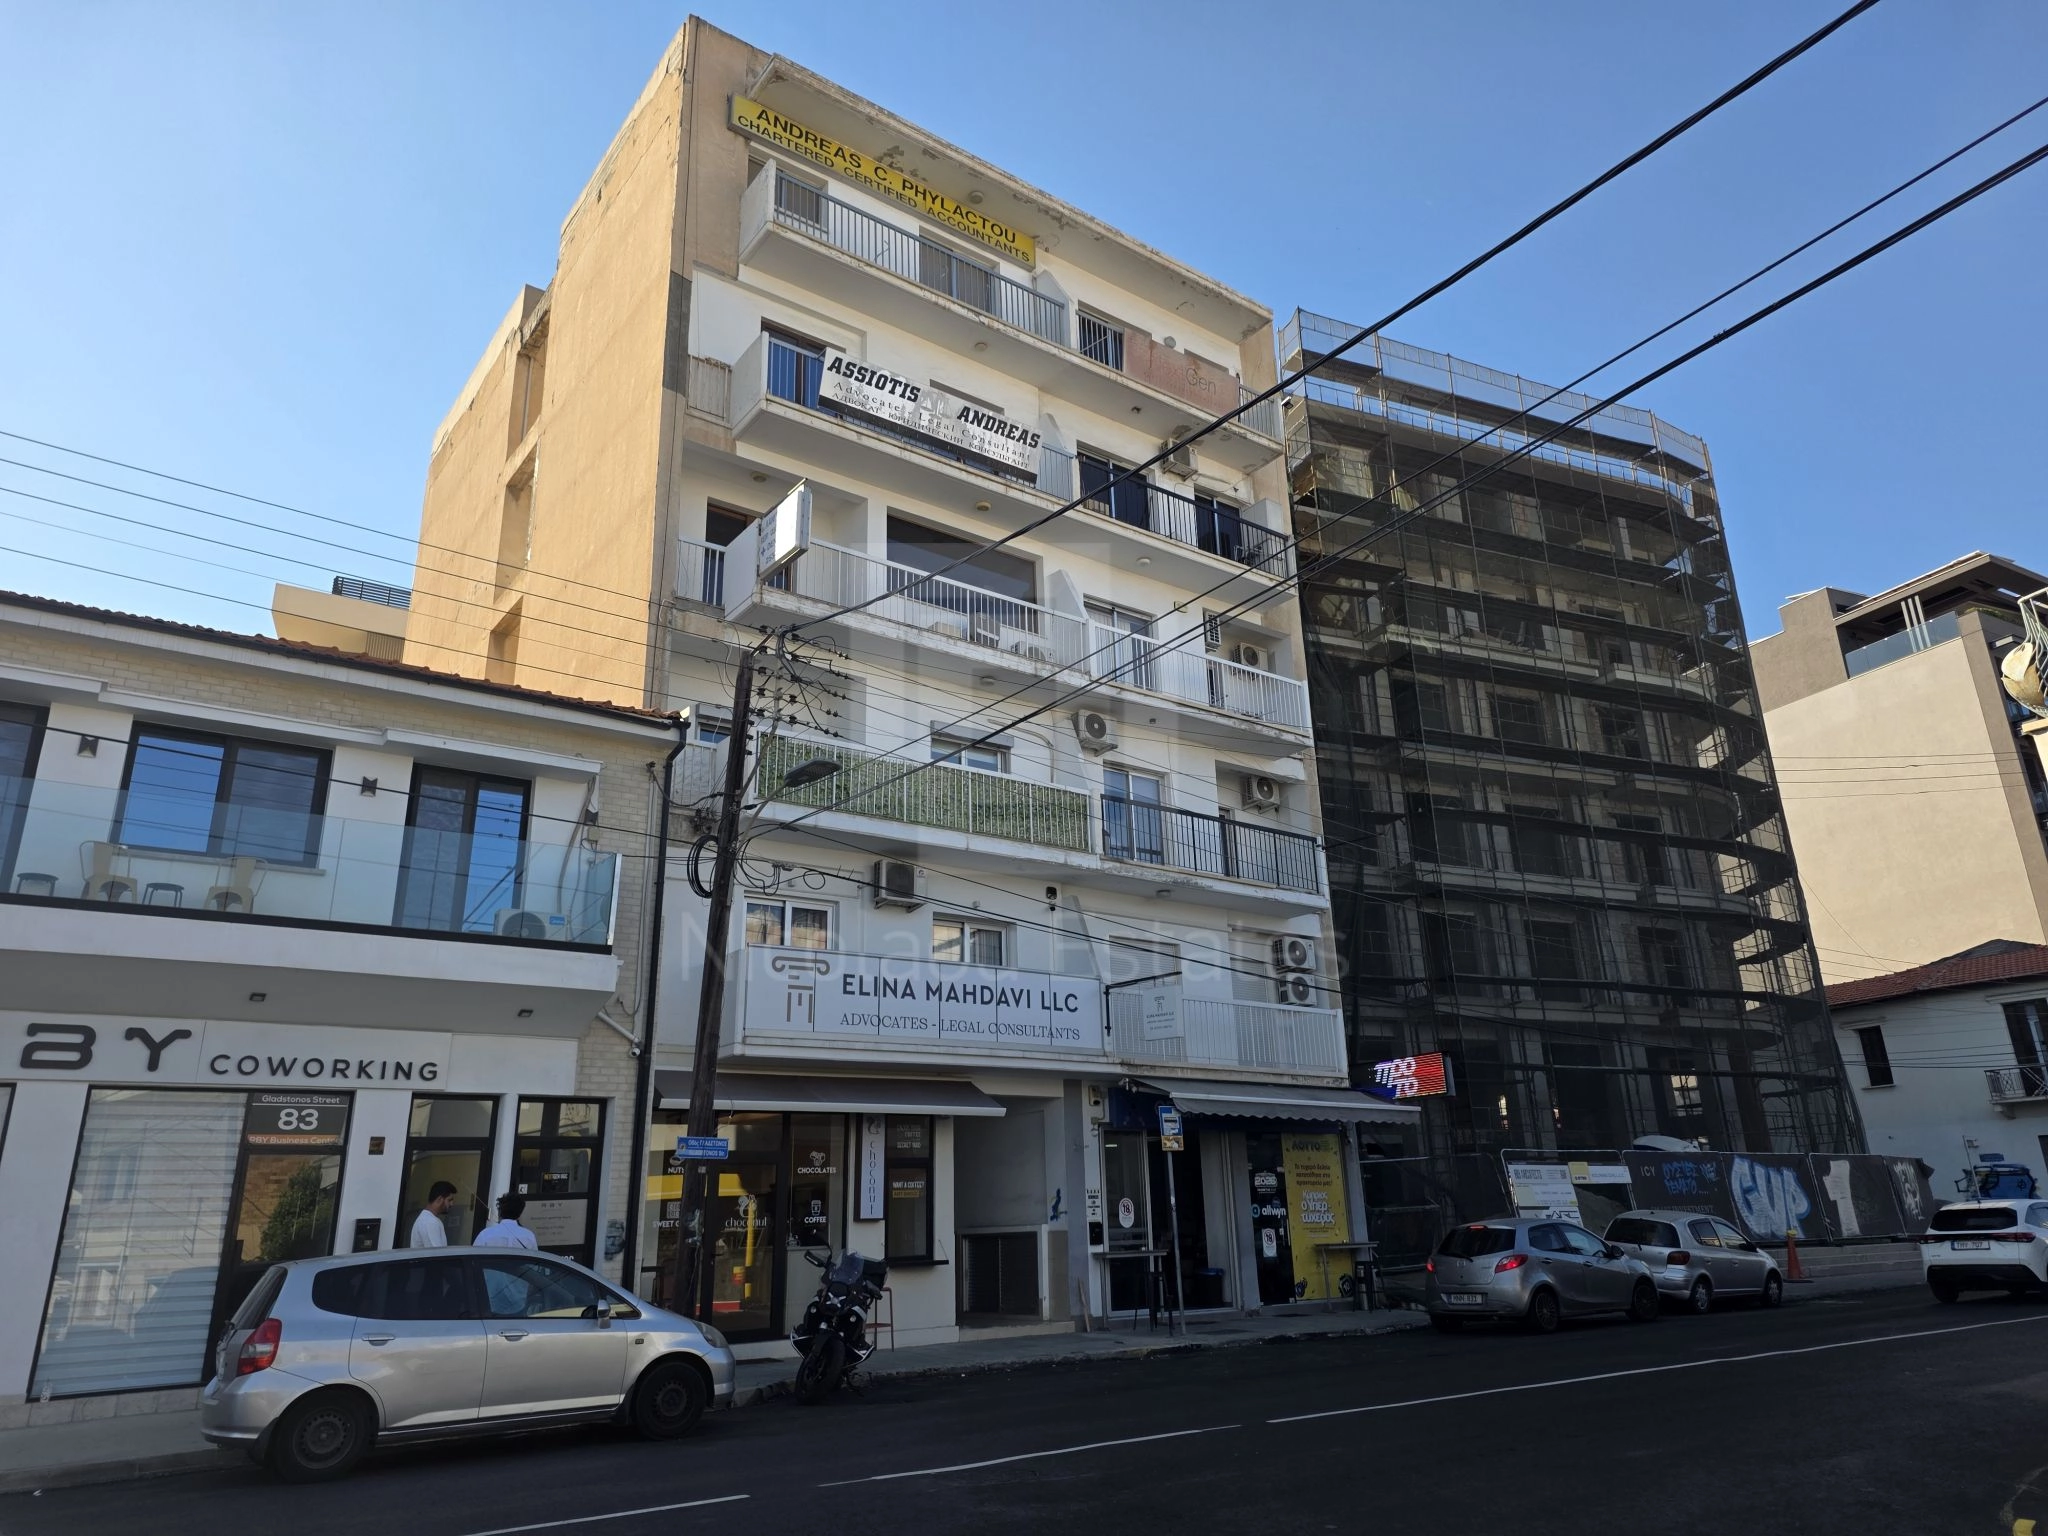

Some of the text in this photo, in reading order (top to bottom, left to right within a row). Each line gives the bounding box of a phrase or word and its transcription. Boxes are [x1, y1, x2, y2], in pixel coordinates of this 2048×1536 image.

[737, 115, 1030, 263] CHARTERED CERTIFIED ACCOUNTANTS
[757, 108, 1017, 244] ANDREAS C. PHYLACTOU
[827, 356, 1041, 449] ASSIOTIS ANDREAS
[832, 393, 882, 414] АДВОКАТ
[919, 412, 955, 433] Legal
[962, 429, 1030, 460] Consultant
[841, 973, 1080, 1013] ELINA MAHDAVI LLC
[840, 1011, 930, 1033] ADVOCATES
[939, 1017, 987, 1037] LEGAL
[988, 1021, 1081, 1042] CONSULTANTS
[210, 1053, 439, 1082] COWORKING
[262, 1094, 340, 1104] Gladstonos Street
[277, 1108, 319, 1131] 83
[270, 1136, 308, 1144] Business
[797, 1166, 837, 1174] CHOCOLATES
[804, 1216, 827, 1224] COFFEE
[1262, 1205, 1287, 1218] allwyn
